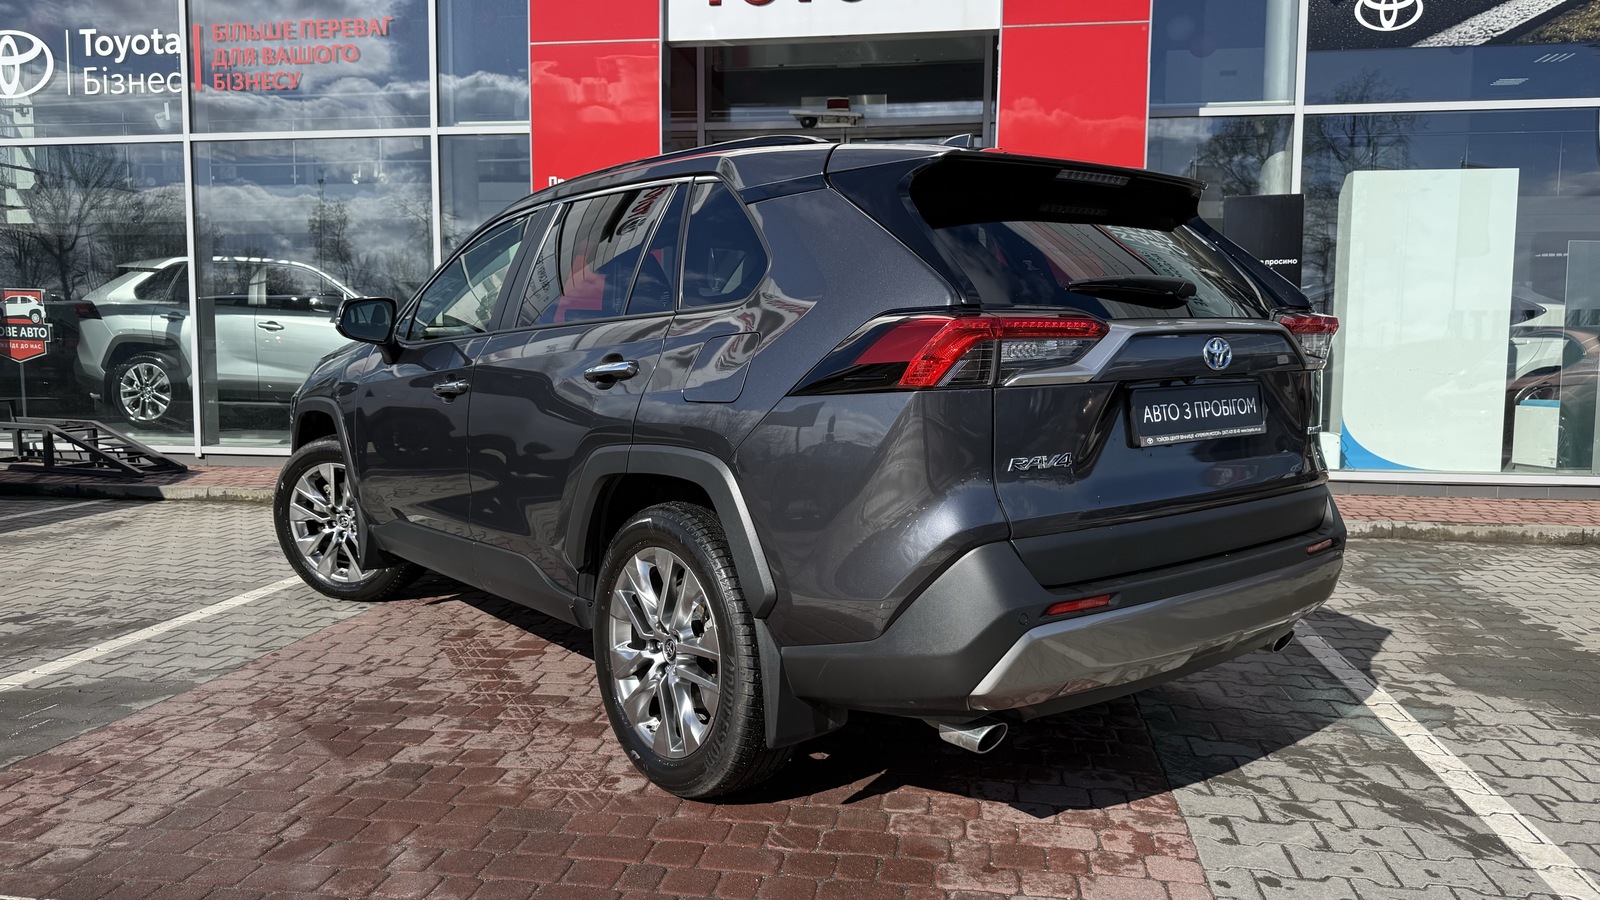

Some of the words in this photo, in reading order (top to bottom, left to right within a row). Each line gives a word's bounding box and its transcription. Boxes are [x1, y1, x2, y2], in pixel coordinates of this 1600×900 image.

[211, 21, 294, 42] БІЛЬШЕ
[300, 17, 392, 38] ПЕРЕВАГ
[79, 28, 180, 63] Toyota
[211, 48, 256, 70] ДЛЯ
[262, 44, 359, 64] ВАШОГО
[83, 66, 182, 95] Бізнес
[213, 71, 301, 91] БІЗНЕСУ
[20, 327, 47, 338] АВТО
[1143, 403, 1180, 424] АВТО
[1193, 397, 1257, 419] ПРОБІГОМ
[1007, 452, 1073, 472] RAV4
